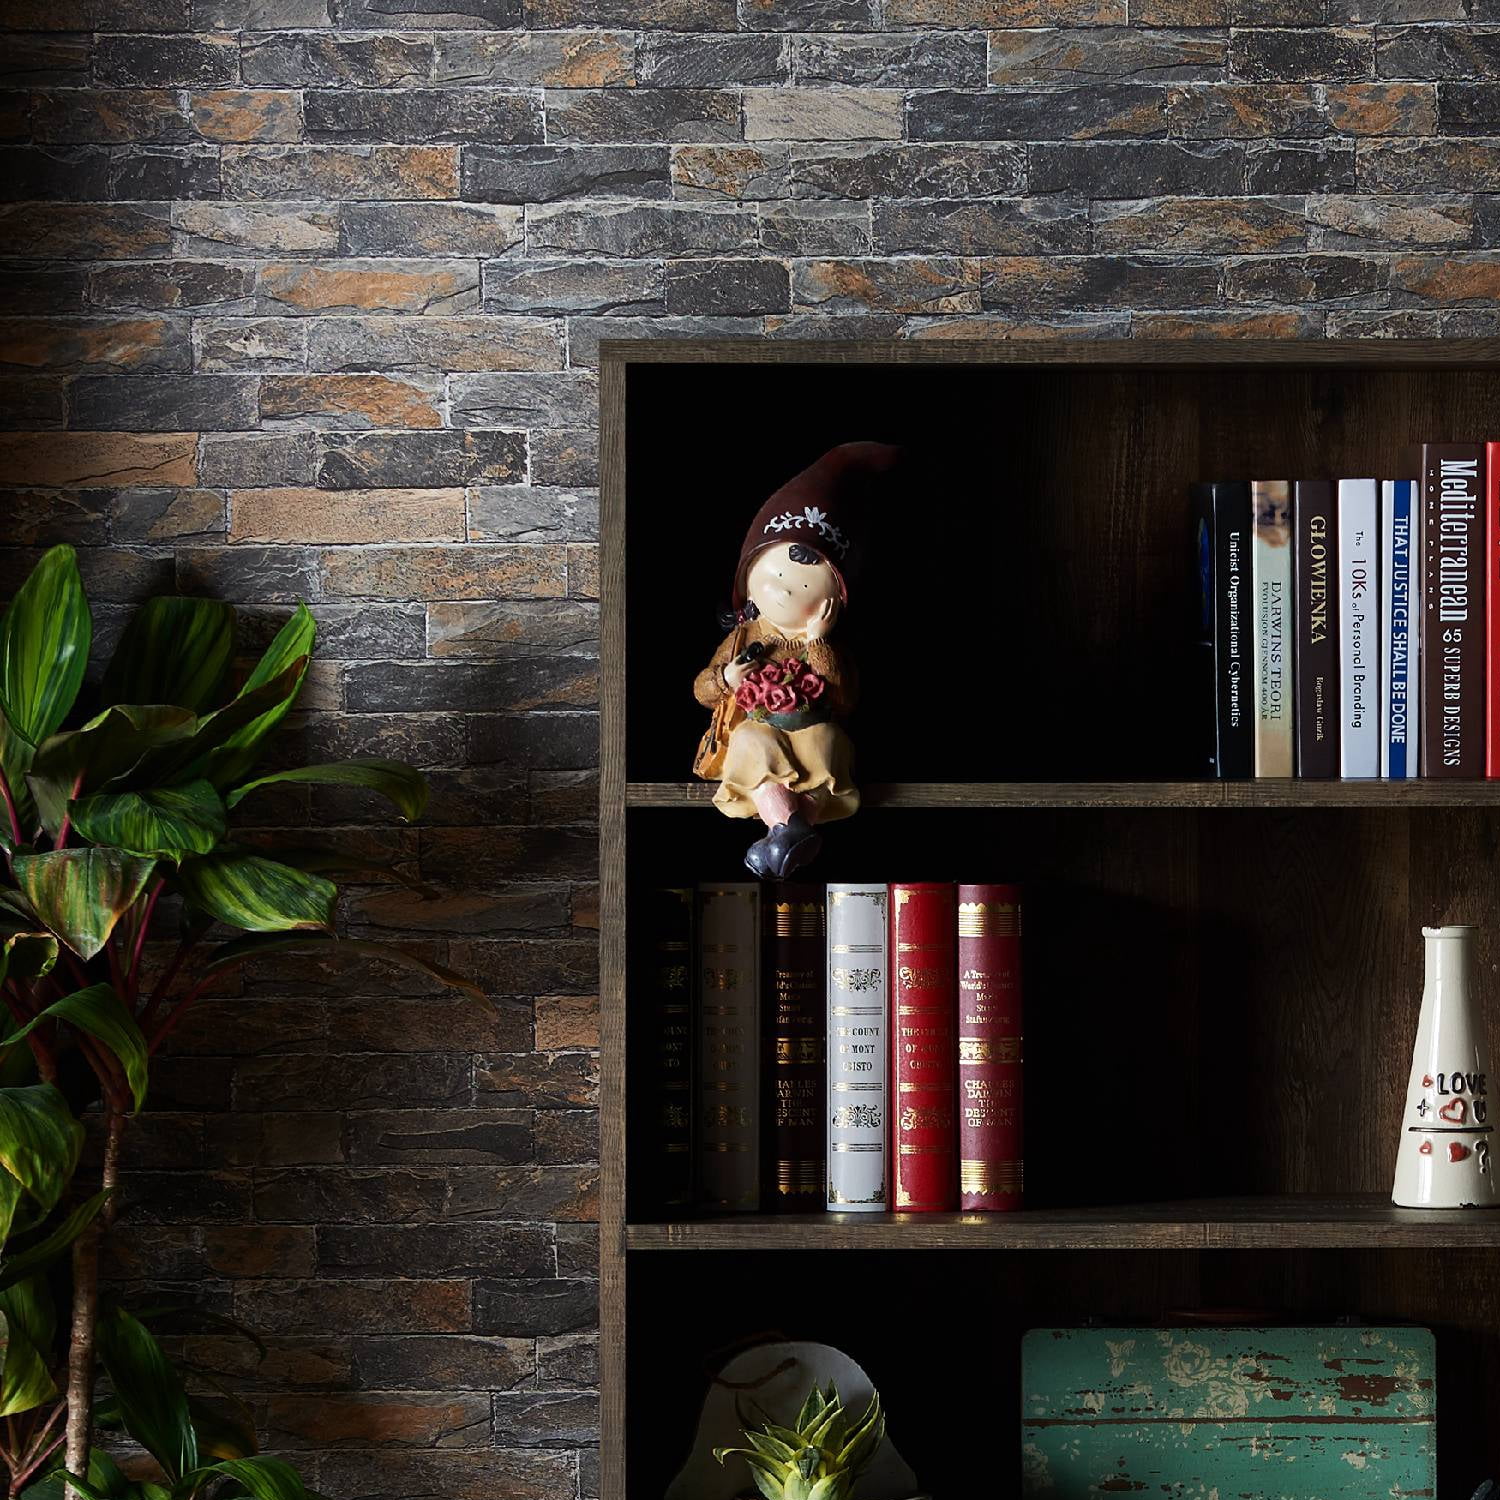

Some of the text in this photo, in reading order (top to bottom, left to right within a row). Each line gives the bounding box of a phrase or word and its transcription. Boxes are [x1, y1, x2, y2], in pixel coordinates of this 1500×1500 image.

[1228, 532, 1241, 728] Unicist Organizational Cybernetics
[1390, 516, 1408, 744] THAT JUSTICE SHALL BE DONE
[1438, 458, 1478, 766] Mediterranean 65 SUPERB DESIGNS
[1270, 582, 1282, 721] DARWINS TEORI
[1353, 614, 1366, 669] Personal
[1351, 674, 1366, 729] Branding
[851, 1044, 876, 1054] MONT
[852, 1027, 880, 1037] COUNT
[1436, 1072, 1488, 1095] LOVE
